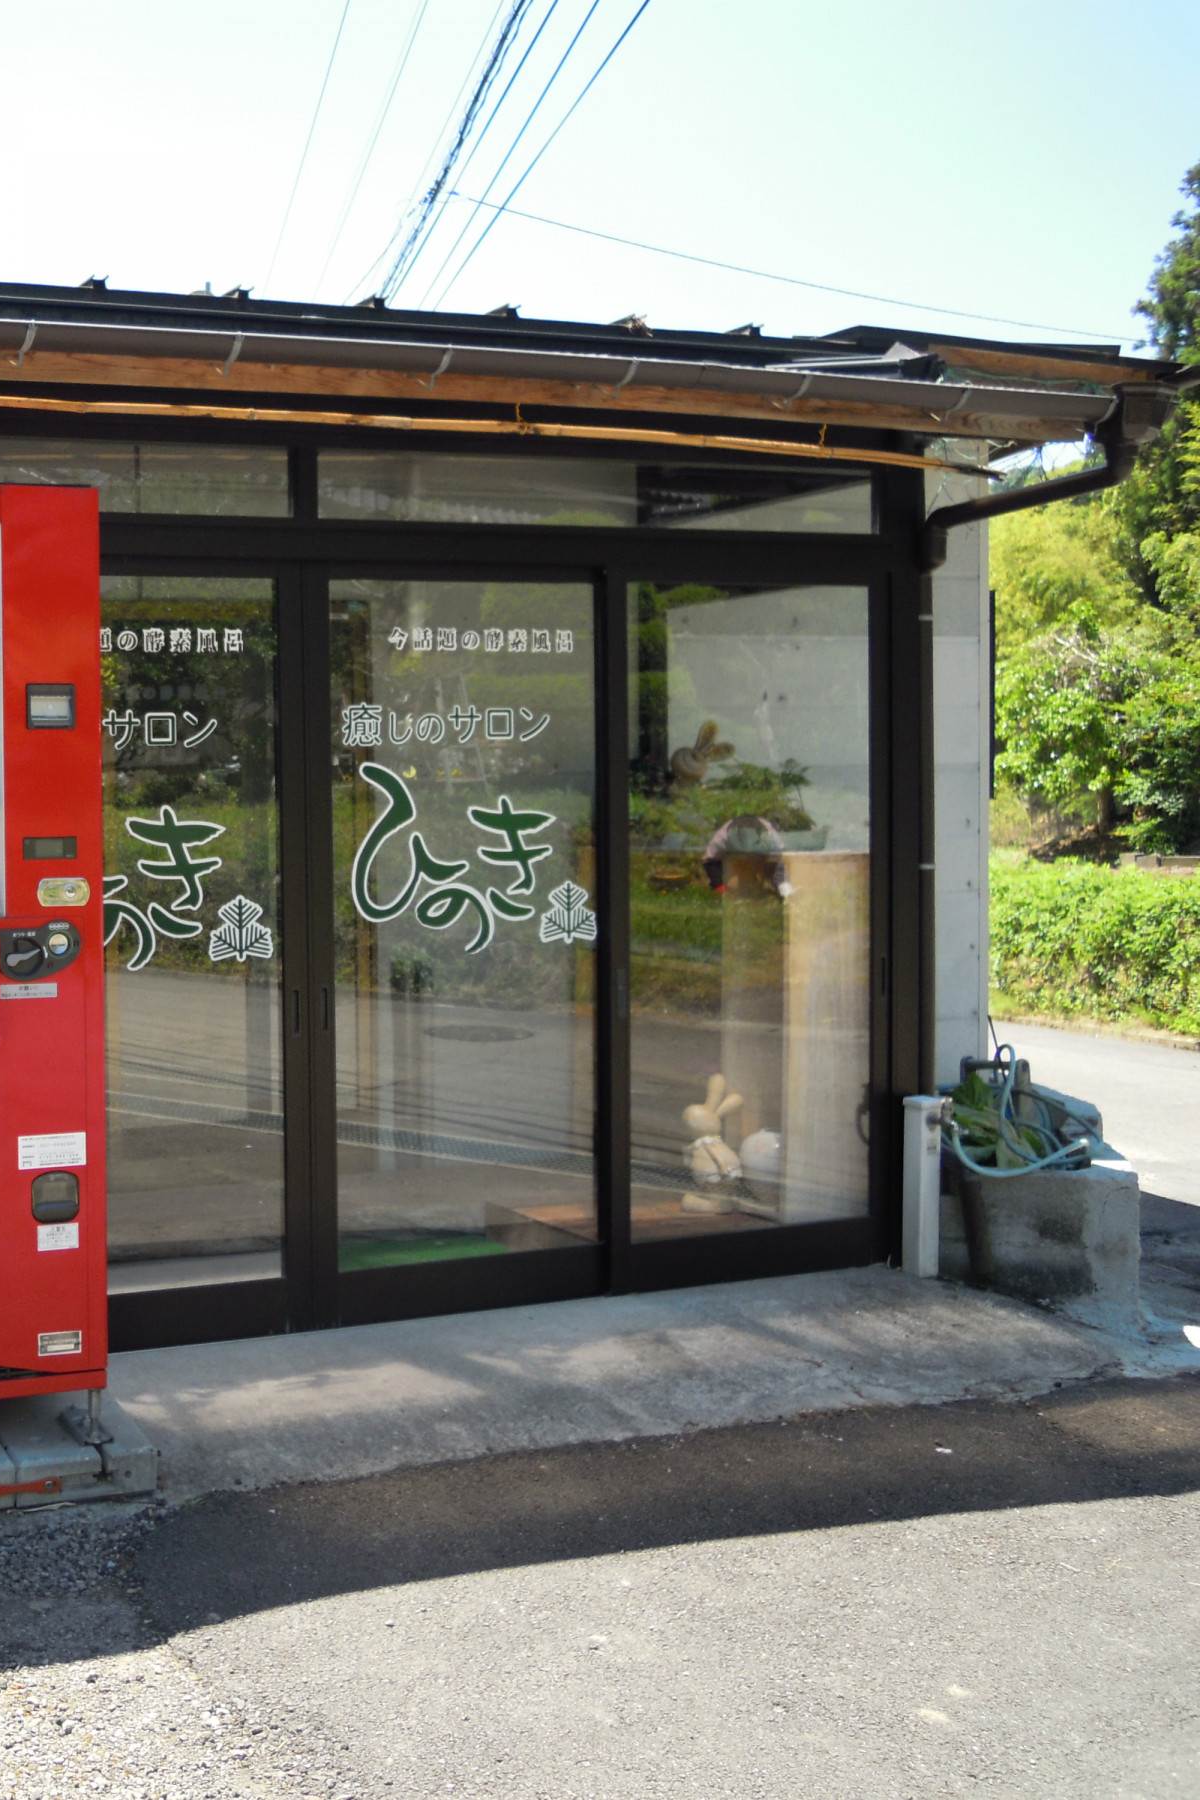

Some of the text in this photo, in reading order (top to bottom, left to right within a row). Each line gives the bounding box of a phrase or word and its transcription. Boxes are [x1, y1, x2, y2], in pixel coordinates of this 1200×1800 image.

[388, 627, 574, 652] 今話題の酵素風呂
[102, 709, 218, 750] サロン
[341, 702, 550, 748] 癒しのサロン
[352, 762, 556, 954] ひのき
[103, 805, 226, 970] のき
